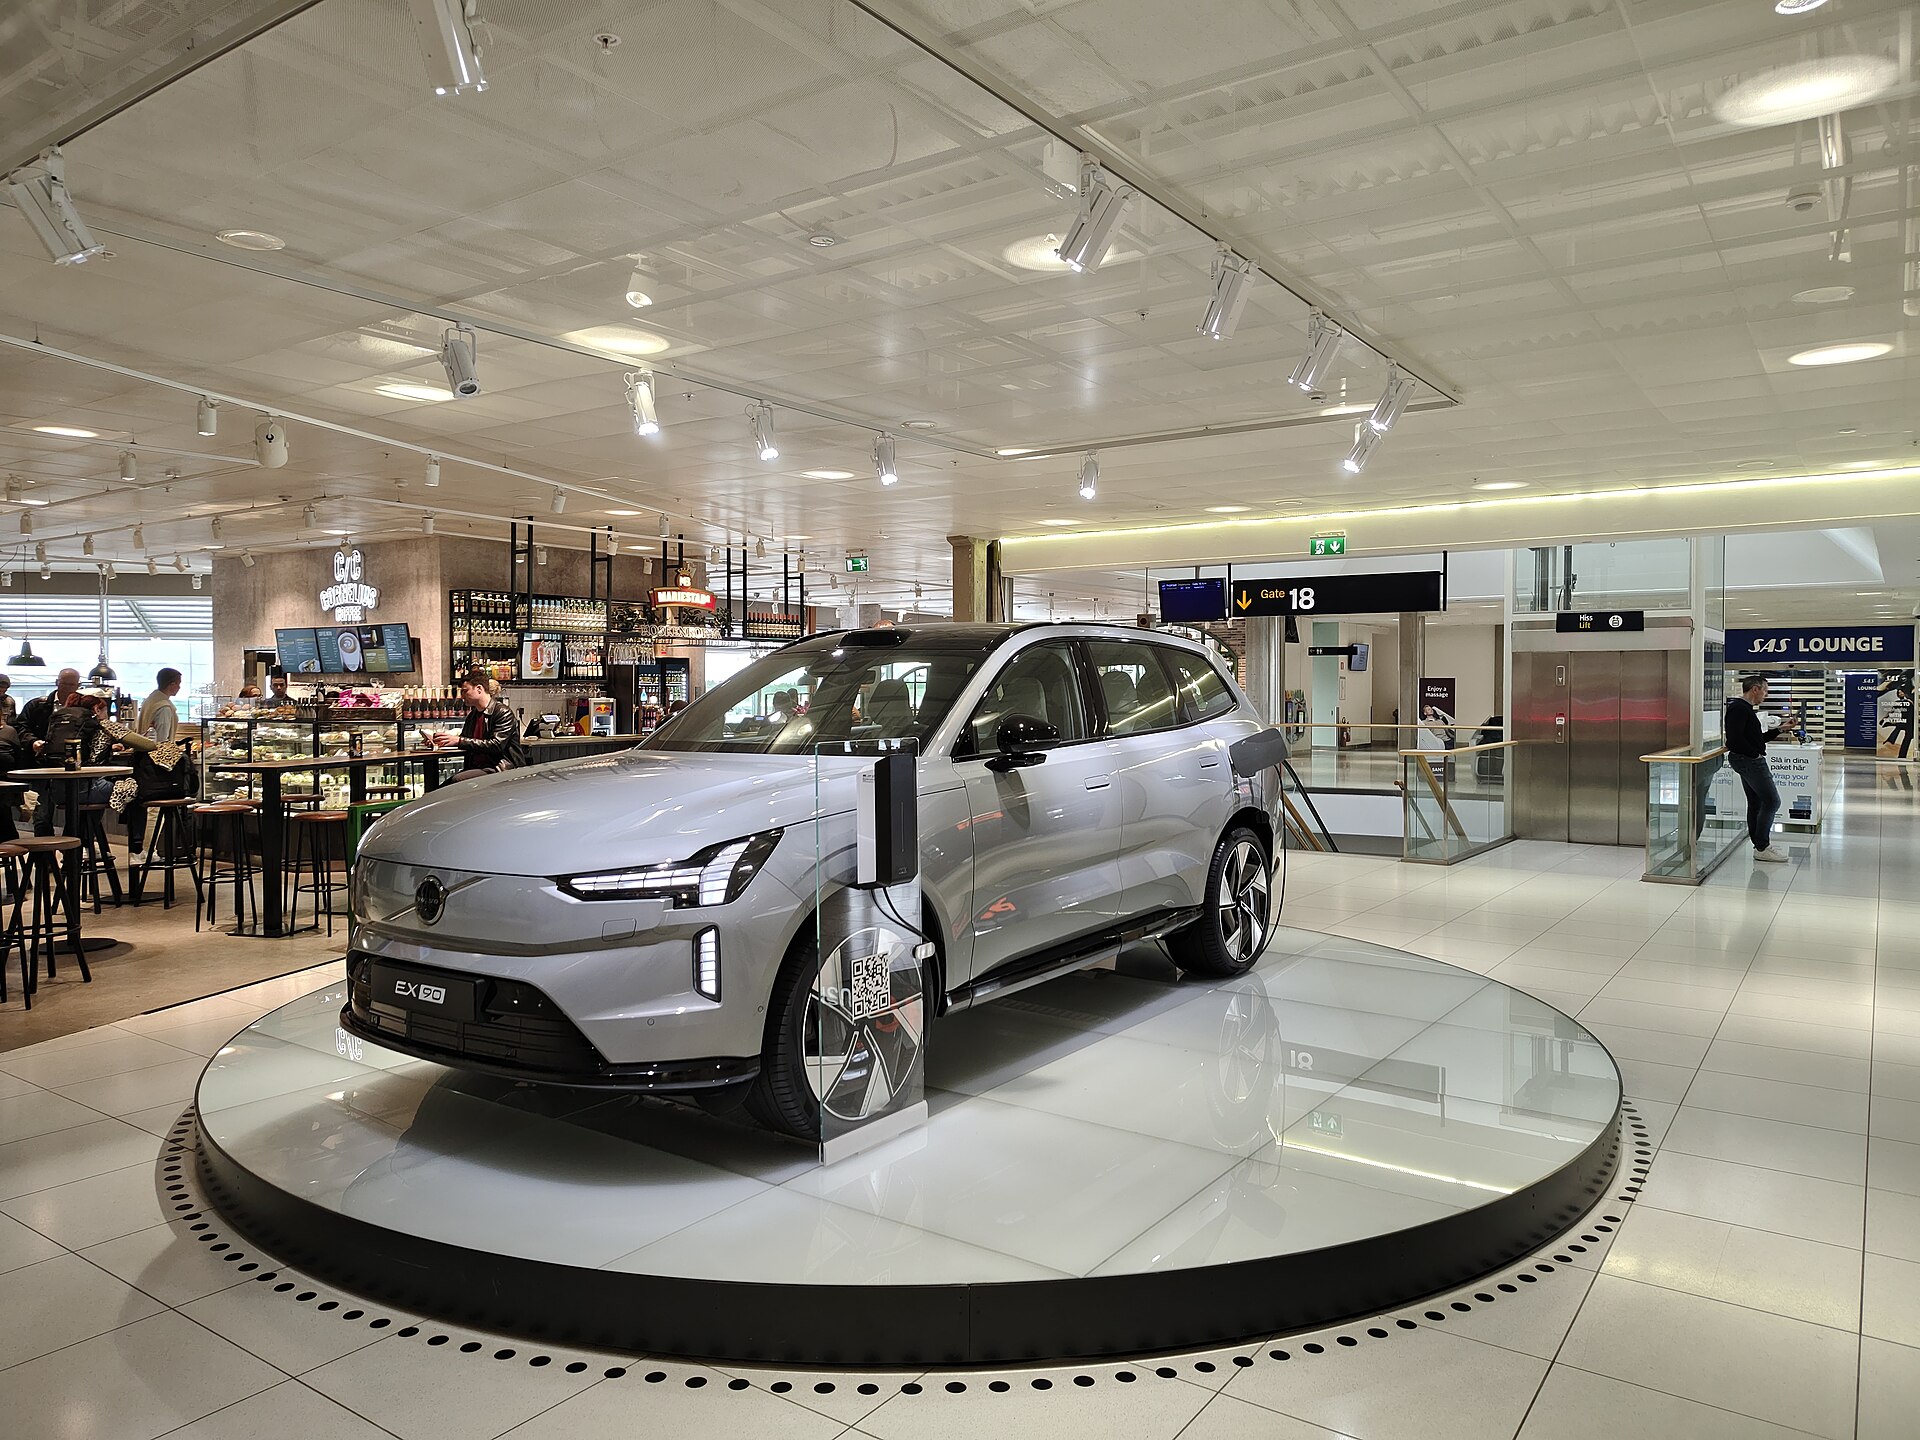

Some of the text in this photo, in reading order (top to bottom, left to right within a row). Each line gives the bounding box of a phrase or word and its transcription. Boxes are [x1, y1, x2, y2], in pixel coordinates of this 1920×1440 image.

[320, 583, 377, 611] CORNELIUS
[1260, 587, 1315, 610] Gate 18
[335, 606, 361, 622] COFFEE
[1747, 636, 1884, 653] SAS LOUNGE
[1427, 685, 1442, 693] Enjoy
